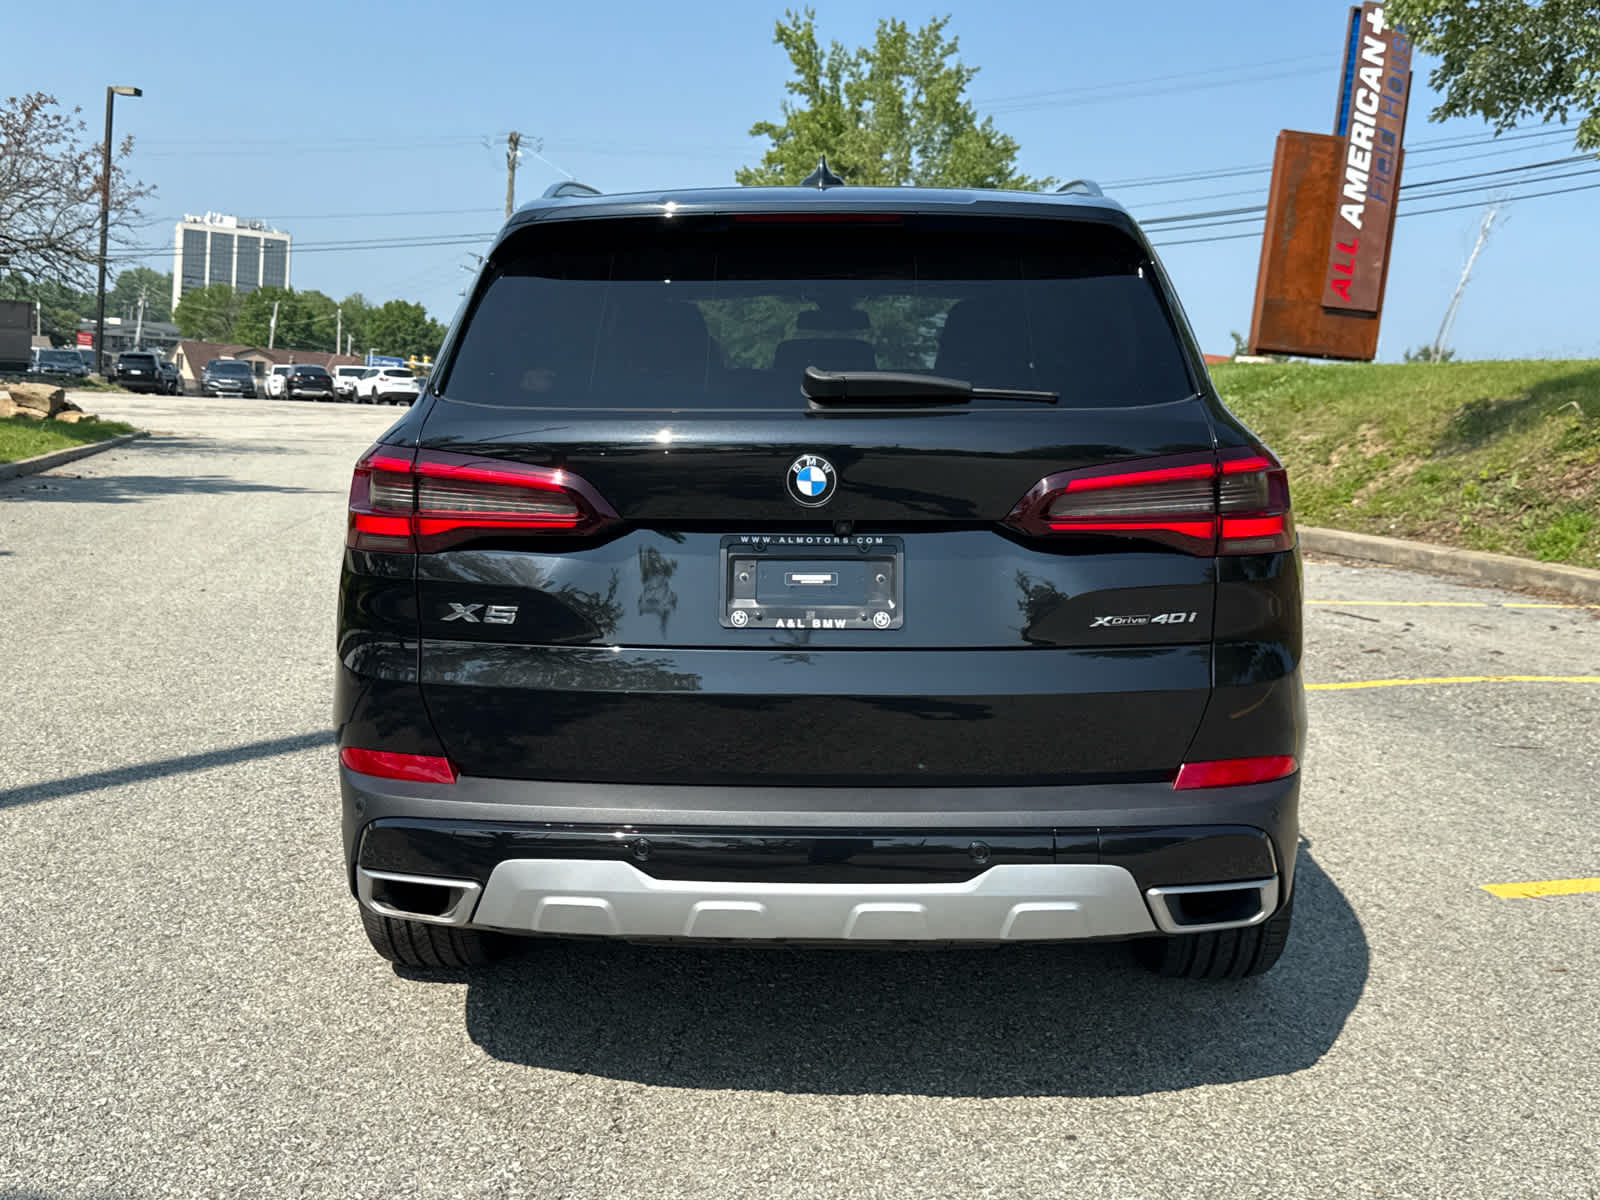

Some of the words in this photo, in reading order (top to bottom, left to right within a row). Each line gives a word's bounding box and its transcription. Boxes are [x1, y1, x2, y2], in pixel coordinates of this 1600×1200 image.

[1340, 35, 1387, 230] AMERICAN
[1368, 126, 1396, 203] Field
[1331, 237, 1359, 302] ALL
[792, 455, 831, 473] BMW
[740, 536, 884, 544] WWW.ALMOTORS.COM
[440, 602, 519, 624] X5
[775, 618, 805, 629] A&L
[812, 619, 846, 629] BMW
